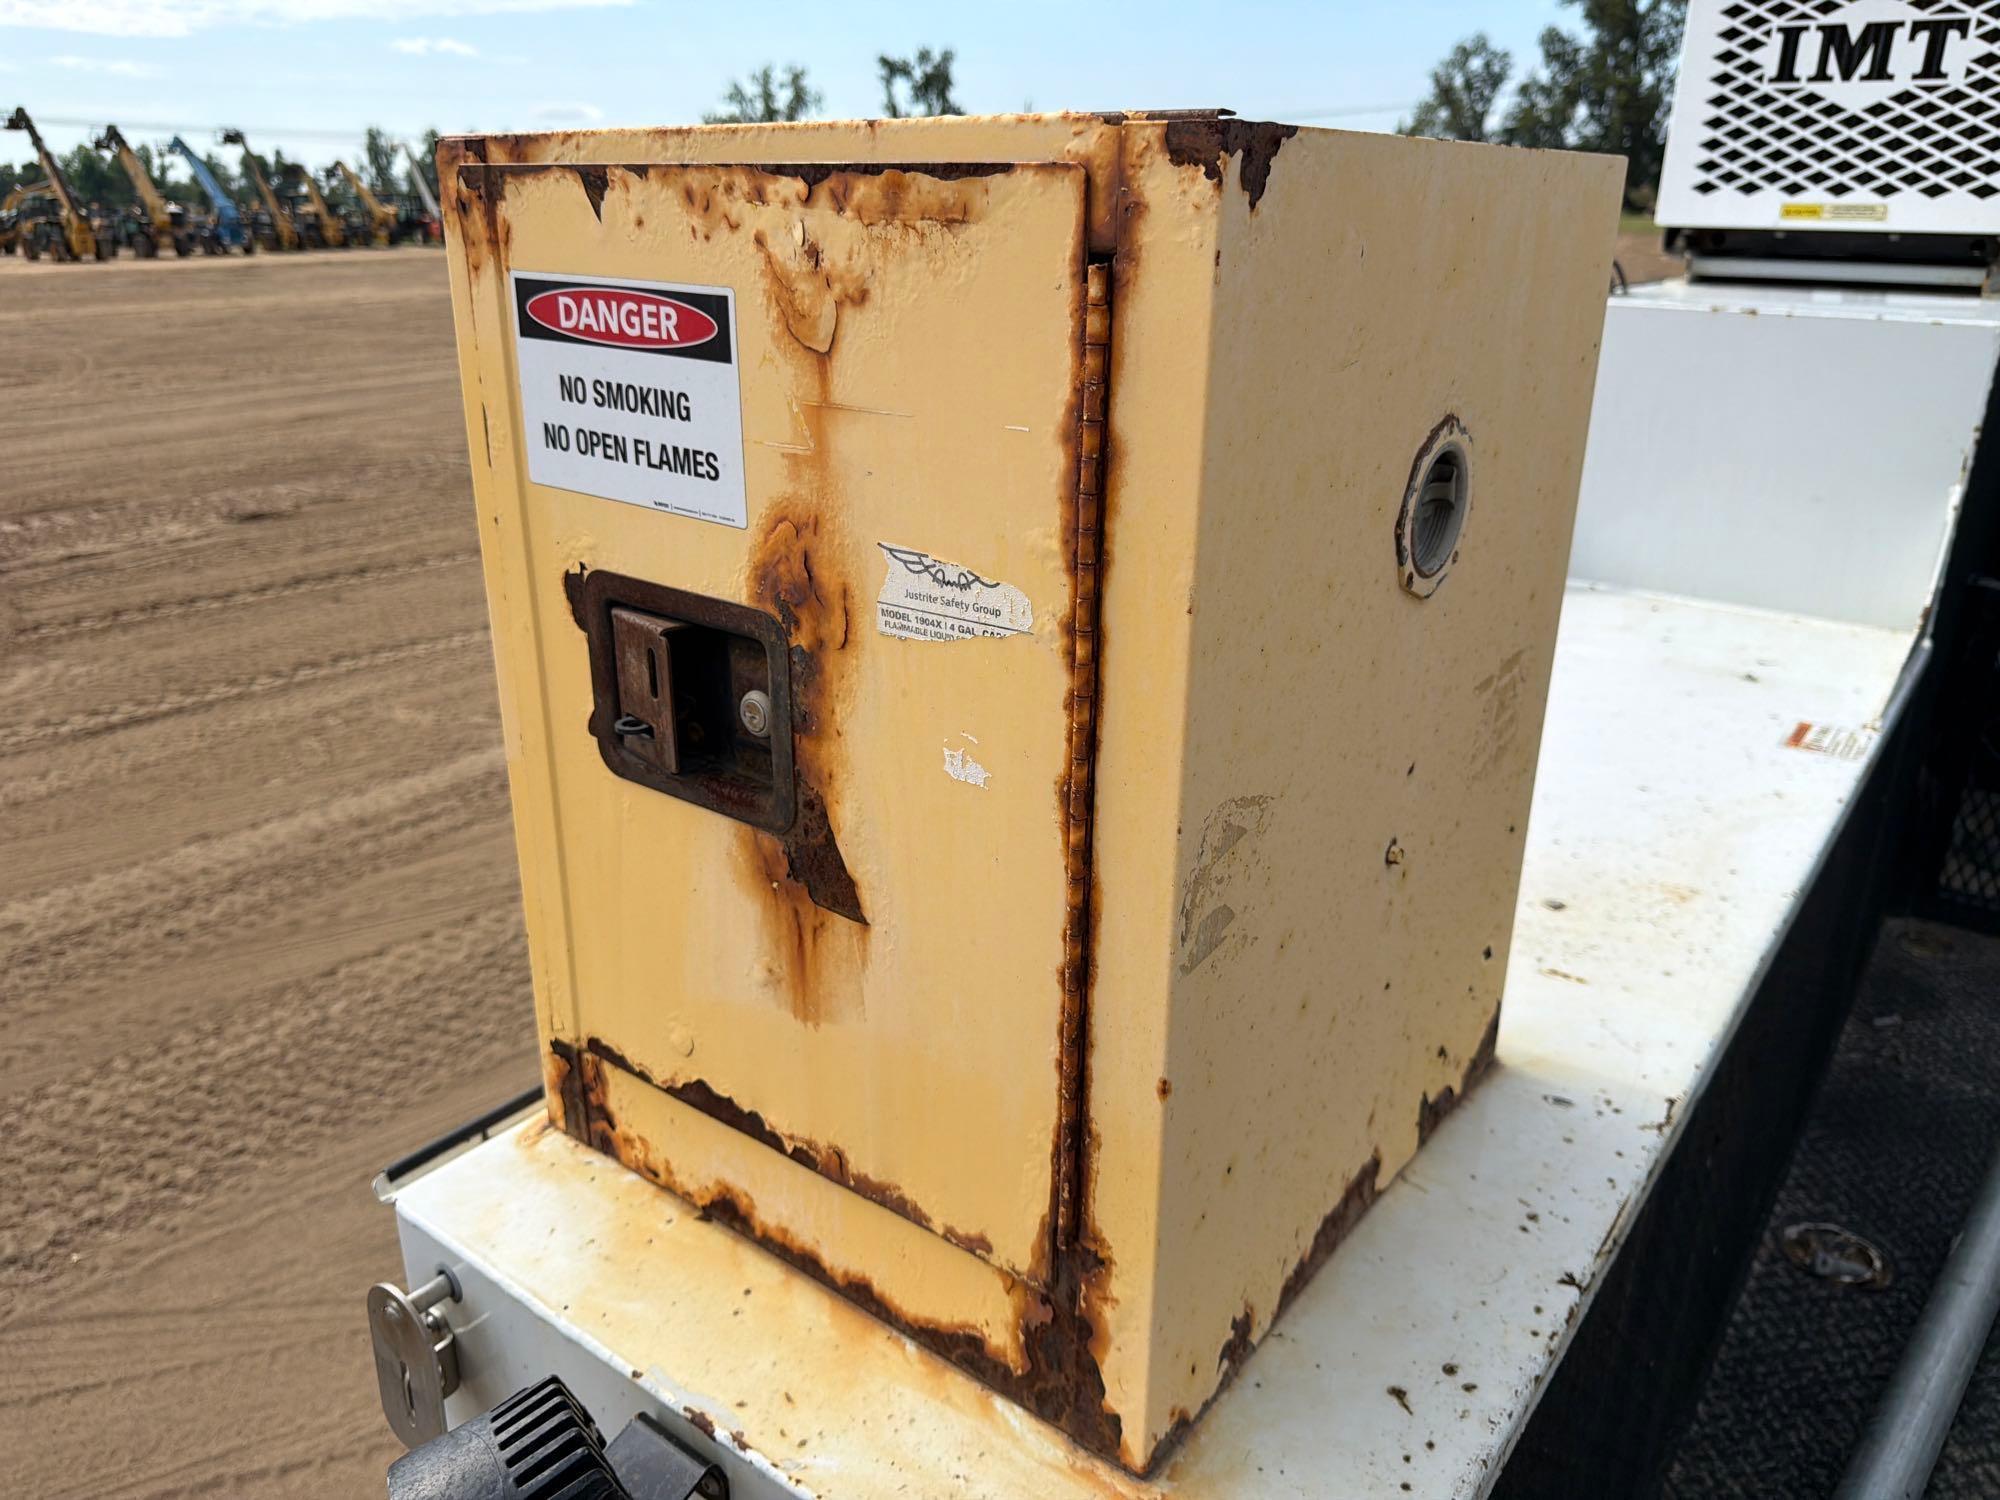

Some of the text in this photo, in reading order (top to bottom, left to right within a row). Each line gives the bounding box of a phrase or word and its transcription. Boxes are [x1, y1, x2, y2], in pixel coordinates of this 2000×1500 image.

[1768, 19, 1971, 84] IMT
[558, 295, 680, 342] DANGER
[559, 374, 692, 422] NO SMOKING
[543, 422, 720, 481] NO OPEN FLAMES
[881, 608, 912, 623] MODEL
[915, 616, 942, 630] 1904X
[949, 620, 955, 632] 4
[904, 589, 1001, 619] Justrite Safety Group
